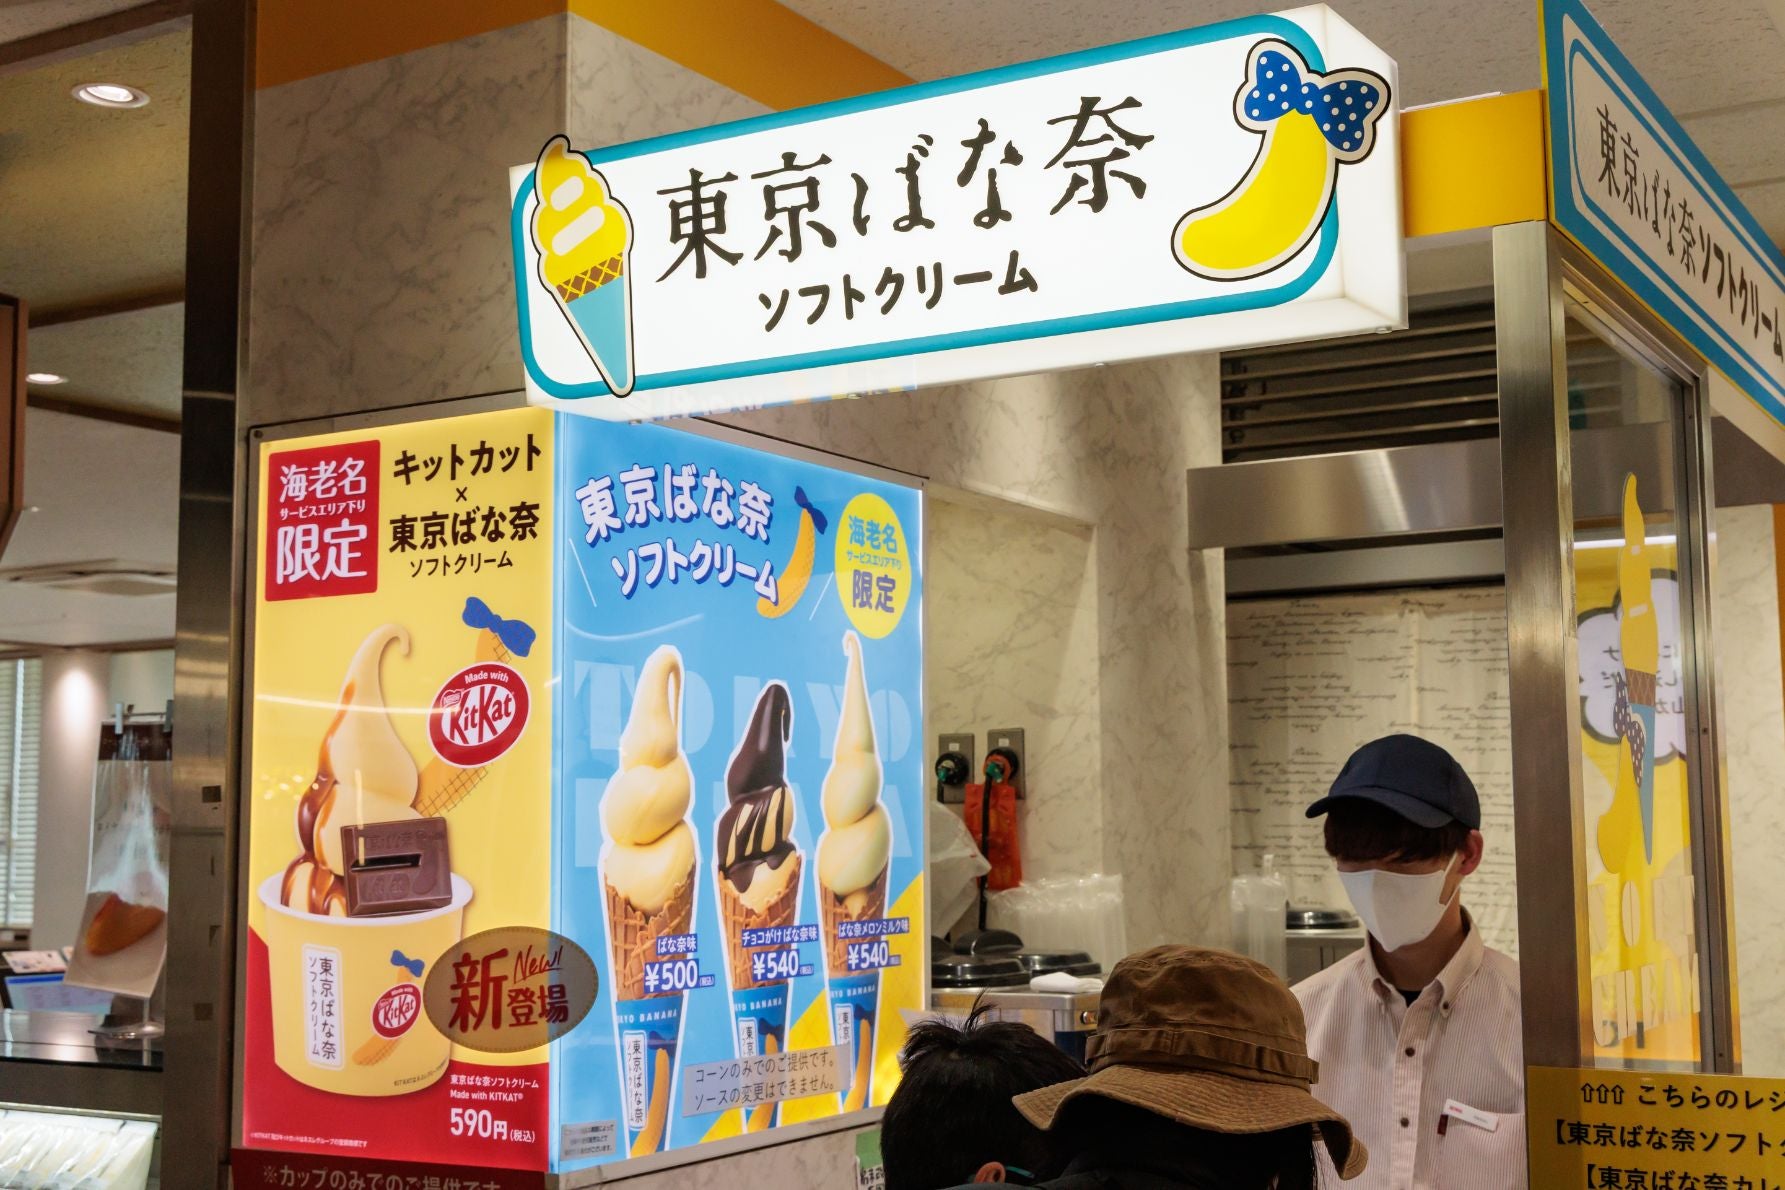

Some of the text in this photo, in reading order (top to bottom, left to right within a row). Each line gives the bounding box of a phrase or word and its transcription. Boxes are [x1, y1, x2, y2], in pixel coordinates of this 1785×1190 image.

[656, 96, 1155, 284] 東京ばな奈
[759, 250, 1038, 333] ソフトクリーム
[393, 434, 541, 485] キットカット
[280, 457, 366, 503] 海老名
[280, 499, 366, 521] サービスエリア下り
[575, 463, 773, 546] 東京ばな奈
[389, 501, 540, 553] 東京ばな奈
[848, 515, 898, 553] 海老名
[276, 518, 368, 585] 限定
[410, 550, 513, 578] ソフトクリーム
[611, 537, 779, 605] ソフトクリーム
[853, 569, 896, 613] 限定
[464, 670, 509, 684] Made with
[449, 685, 513, 745] KitKat
[658, 935, 697, 954] ばな奈味
[838, 918, 909, 938] ばな奈メロンミルク味
[753, 951, 799, 979] ¥540
[848, 942, 888, 970] ¥540
[644, 960, 699, 993] ¥500
[309, 956, 320, 1056] ソフトクリーム
[319, 957, 337, 1060] 東京ばな奈
[640, 1009, 678, 1022] BANANA
[450, 1074, 540, 1088] 東京ばな奈ソフトクリーム
[632, 1040, 643, 1123] 東京ばな奈
[696, 1050, 834, 1082] コーンのみでのご提供です。
[450, 1089, 470, 1099] Made
[471, 1091, 488, 1100] with
[695, 1075, 834, 1111] ソースの変更はできません。
[450, 1107, 508, 1140] 590円
[510, 1129, 536, 1143] (税込)
